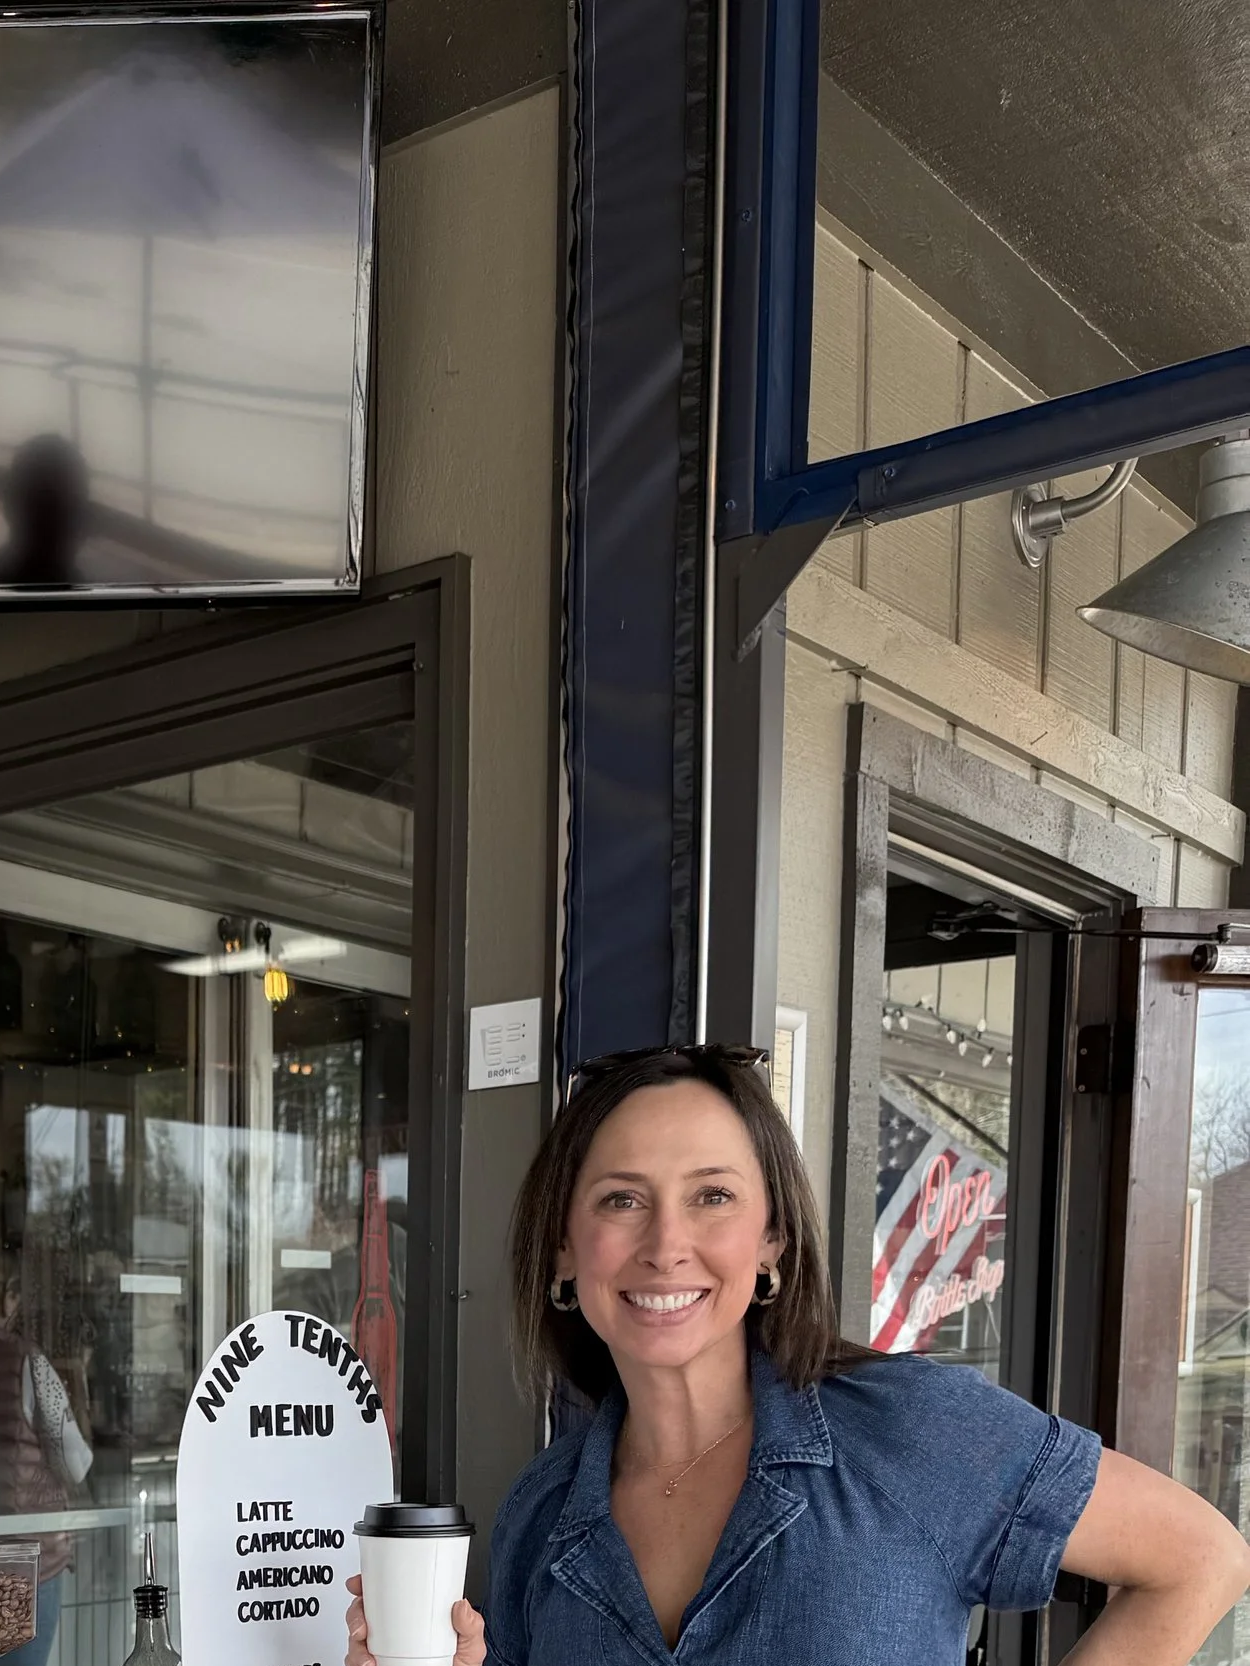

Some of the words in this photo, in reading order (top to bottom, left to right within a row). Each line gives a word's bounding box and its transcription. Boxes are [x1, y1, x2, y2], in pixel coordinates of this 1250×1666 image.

[919, 1153, 996, 1255] Open
[196, 1323, 264, 1423] NINE
[285, 1315, 382, 1423] TENTHS
[250, 1403, 334, 1438] MENU
[236, 1500, 293, 1522] LATTE
[236, 1528, 345, 1556] CAPPUCCINO
[236, 1565, 334, 1591] AMERICANO
[237, 1597, 320, 1623] CORTADO
